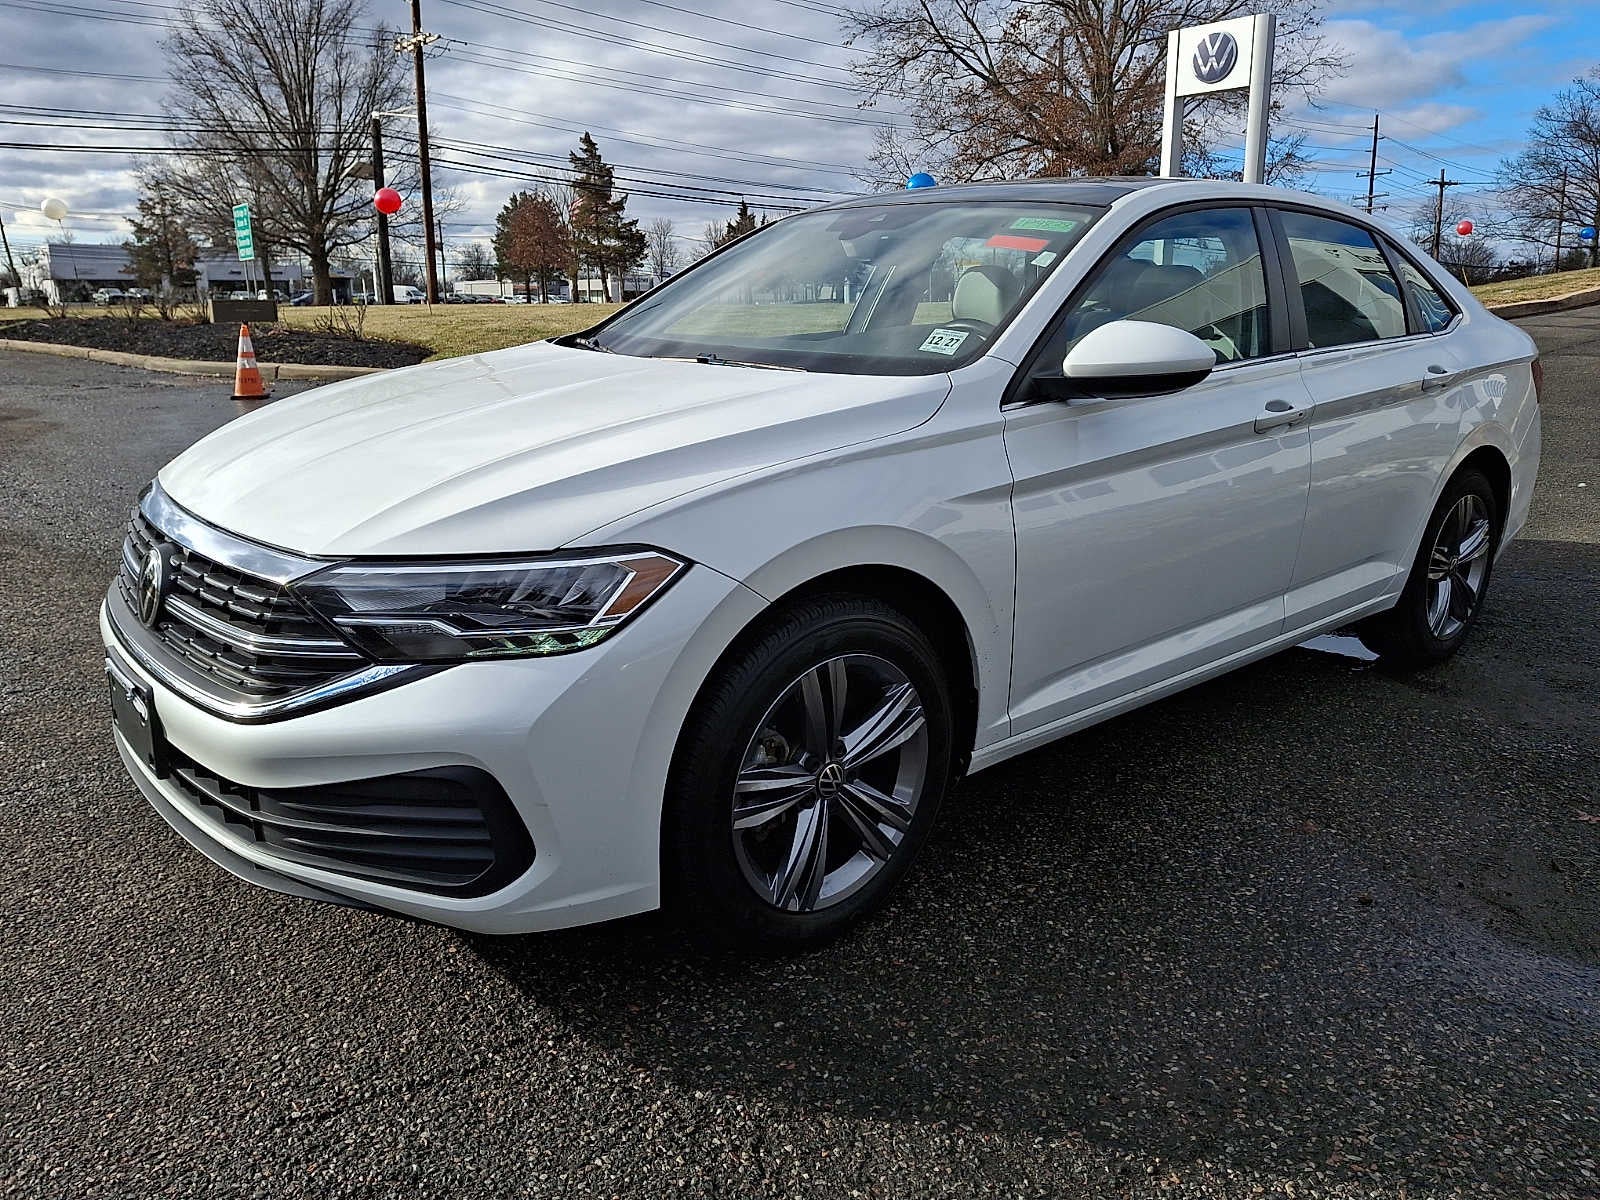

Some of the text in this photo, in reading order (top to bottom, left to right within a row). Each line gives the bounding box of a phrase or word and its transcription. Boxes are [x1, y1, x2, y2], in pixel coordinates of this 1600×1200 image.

[1193, 32, 1237, 81] VW
[928, 335, 960, 348] 12 27
